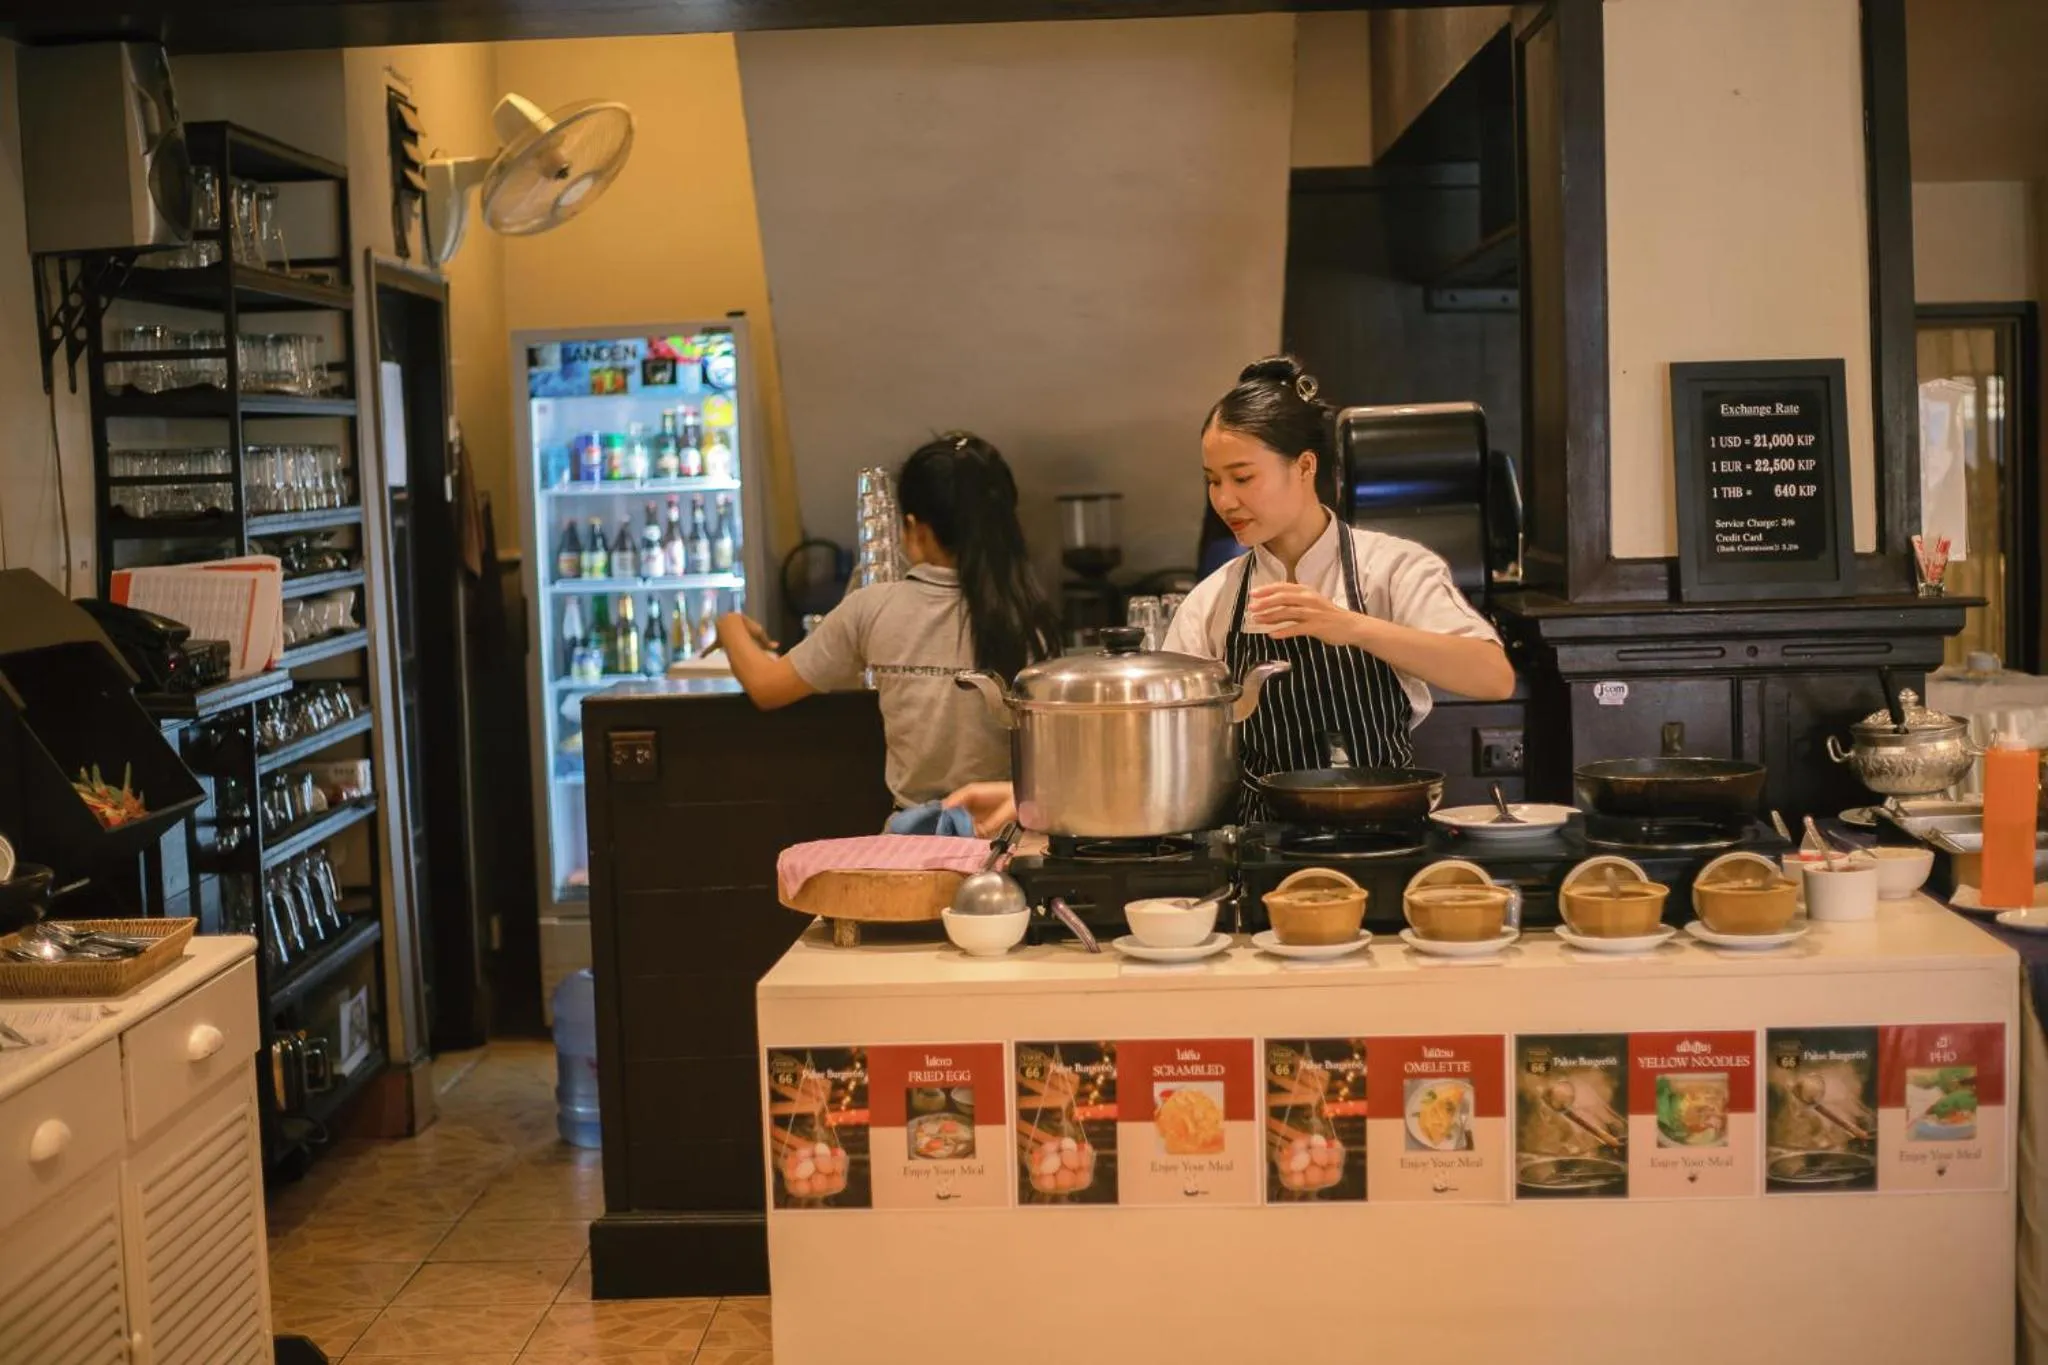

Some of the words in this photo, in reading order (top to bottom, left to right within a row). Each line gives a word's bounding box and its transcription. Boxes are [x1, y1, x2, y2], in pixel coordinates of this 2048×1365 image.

[1720, 403, 1772, 417] Exchange
[1775, 402, 1800, 416] Rate
[1710, 436, 1716, 448] 1
[1719, 436, 1742, 448] USD
[1753, 433, 1794, 450] 21,000
[1797, 434, 1815, 446] KIP
[1711, 461, 1717, 473] 1
[1721, 461, 1742, 473] EUR
[1754, 459, 1795, 474] 22,500
[1798, 459, 1816, 471] KIP
[1712, 487, 1718, 499] 1
[1721, 486, 1743, 498] THB
[1774, 484, 1796, 497] 640
[1799, 484, 1817, 497] KIP
[1715, 519, 1745, 529] Service
[1746, 518, 1779, 530] Charge:
[1715, 532, 1741, 543] Credit
[1743, 532, 1763, 542] Card
[1404, 1060, 1472, 1074] OMELETTE
[1637, 1056, 1688, 1069] YELLOW
[1691, 1055, 1751, 1068] NOODLES
[908, 1070, 944, 1082] FRIED
[945, 1070, 972, 1082] EGG
[1152, 1063, 1226, 1077] SCRAMBLED
